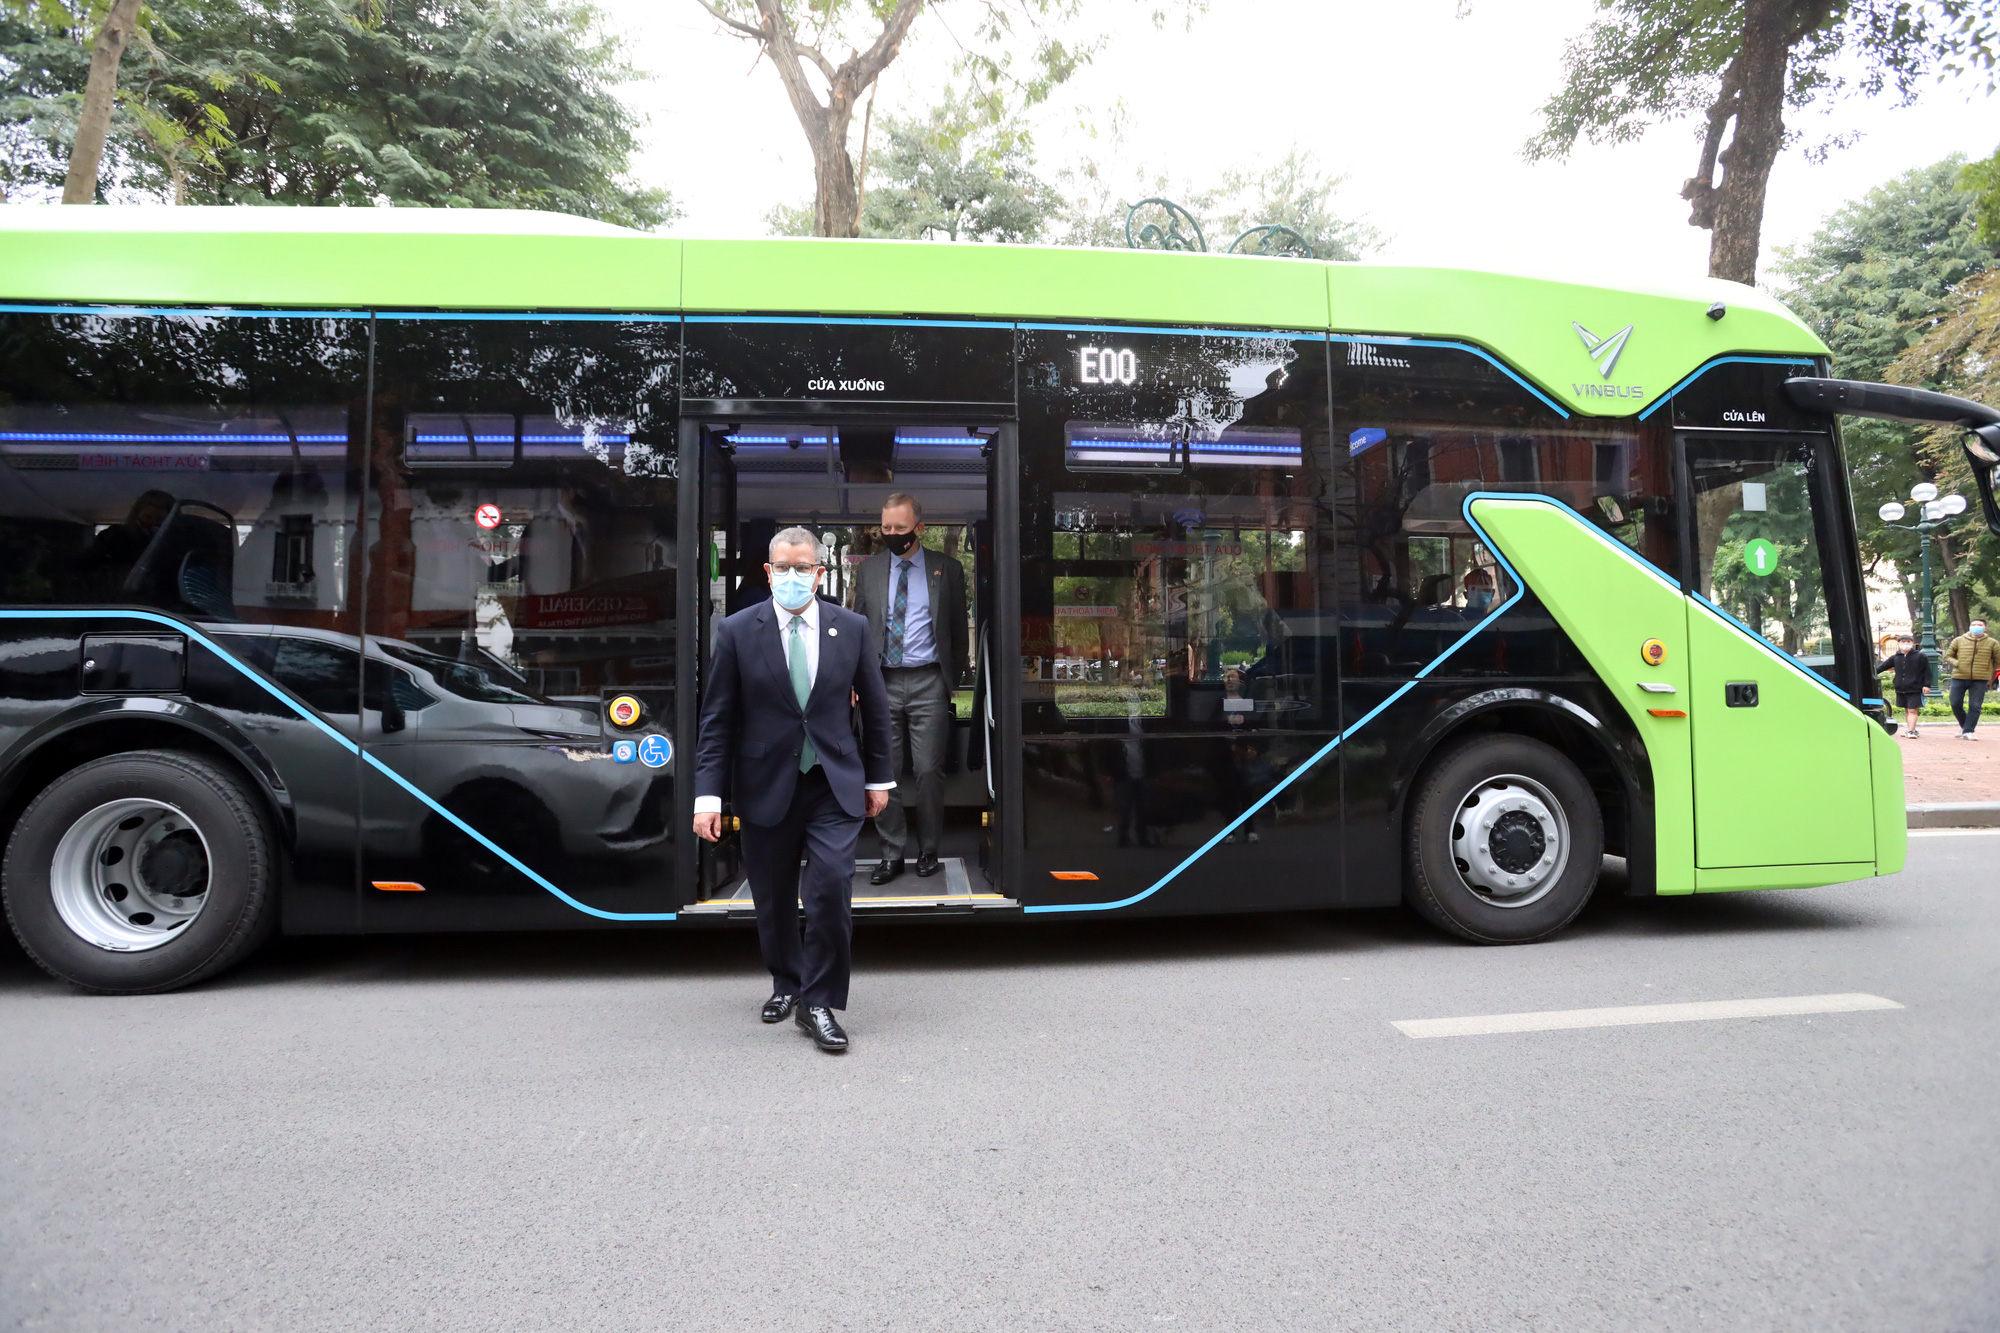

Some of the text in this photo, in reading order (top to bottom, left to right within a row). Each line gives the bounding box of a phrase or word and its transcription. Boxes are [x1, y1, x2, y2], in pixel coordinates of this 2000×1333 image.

[1081, 348, 1136, 384] E00
[807, 377, 885, 391] CỬA XUỐNG
[1572, 383, 1644, 399] VINBUS
[1723, 409, 1766, 422] CỬA LÊN
